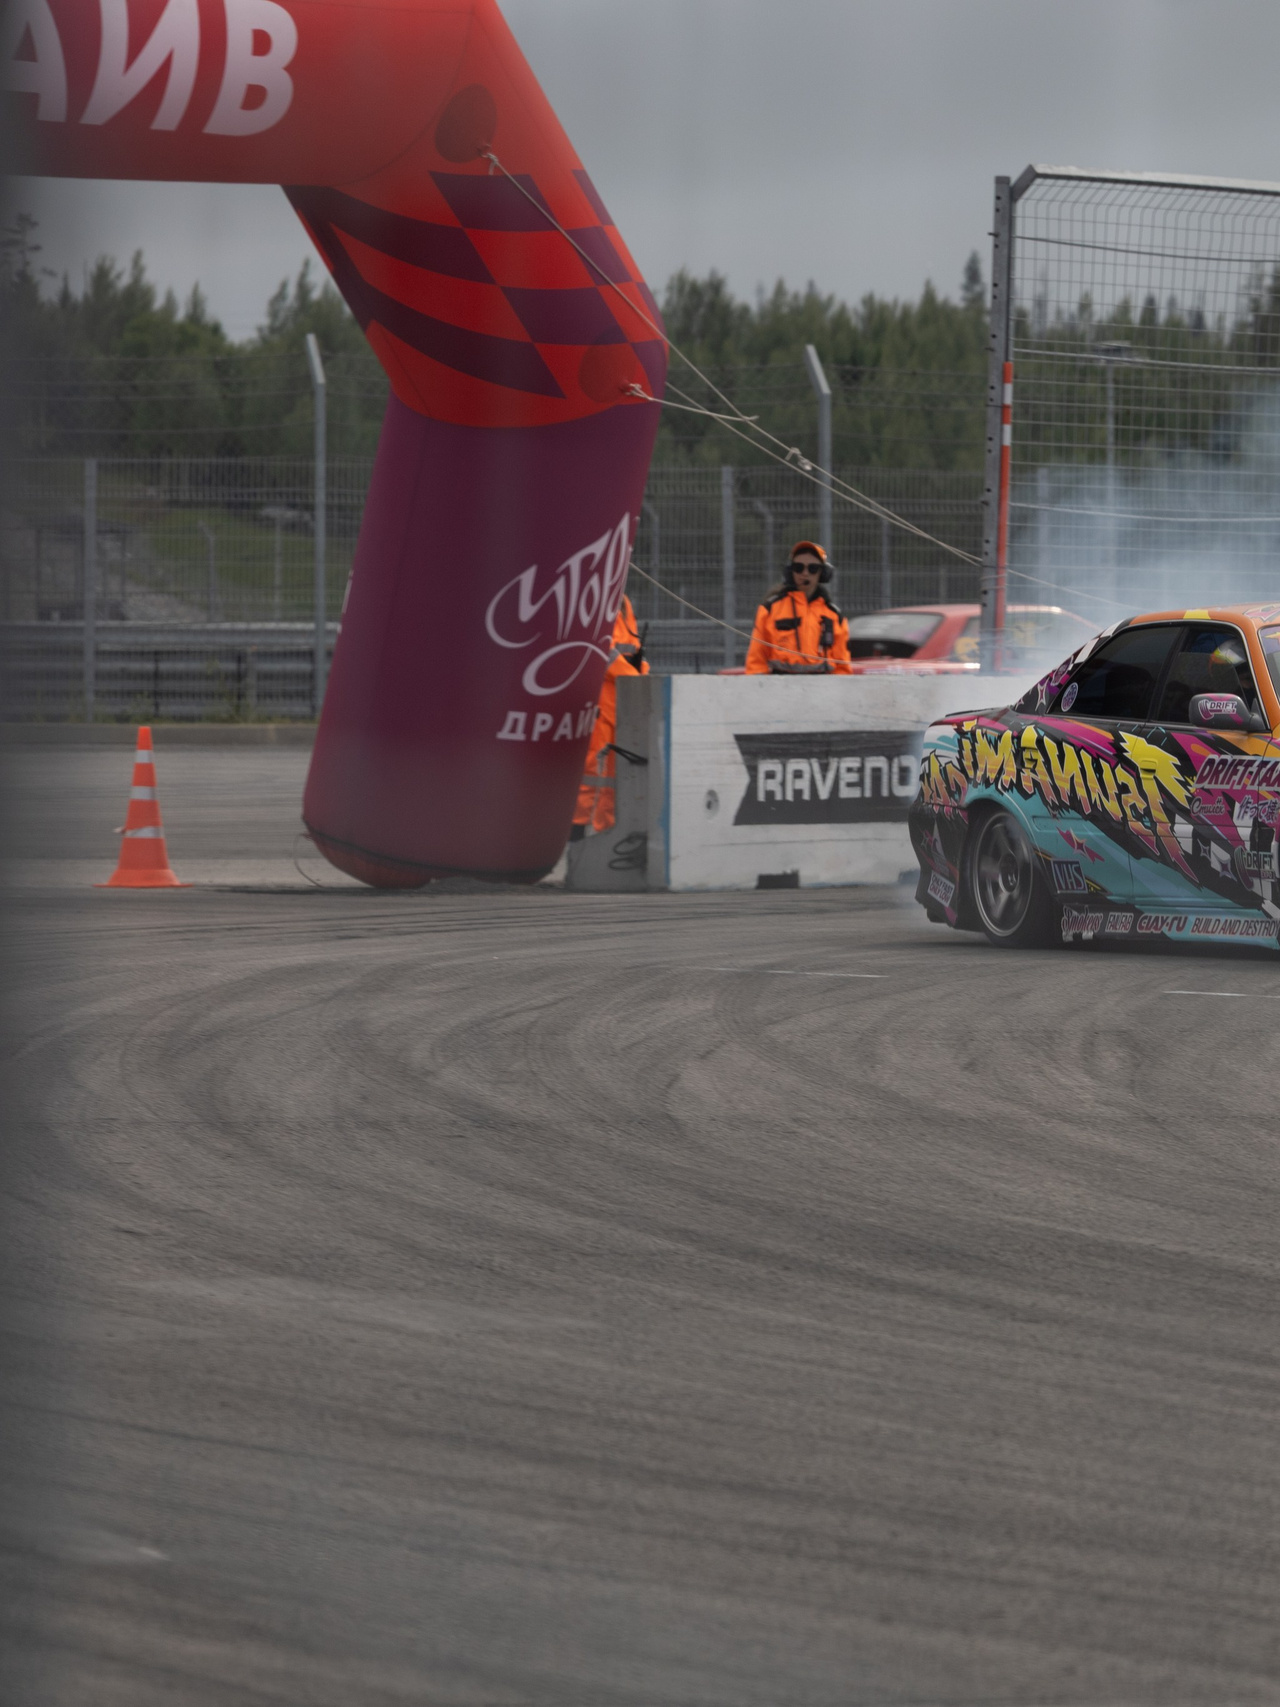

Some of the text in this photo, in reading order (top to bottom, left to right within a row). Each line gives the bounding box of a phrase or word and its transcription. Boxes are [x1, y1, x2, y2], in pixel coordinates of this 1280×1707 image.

[1209, 701, 1237, 709] DRIFT
[757, 755, 919, 802] RAVENO
[1246, 852, 1273, 869] DRIFT
[1054, 863, 1085, 890] VHS
[1191, 917, 1221, 935] BUILD
[1219, 919, 1242, 935] AND
[1239, 918, 1280, 936] DESTROY
